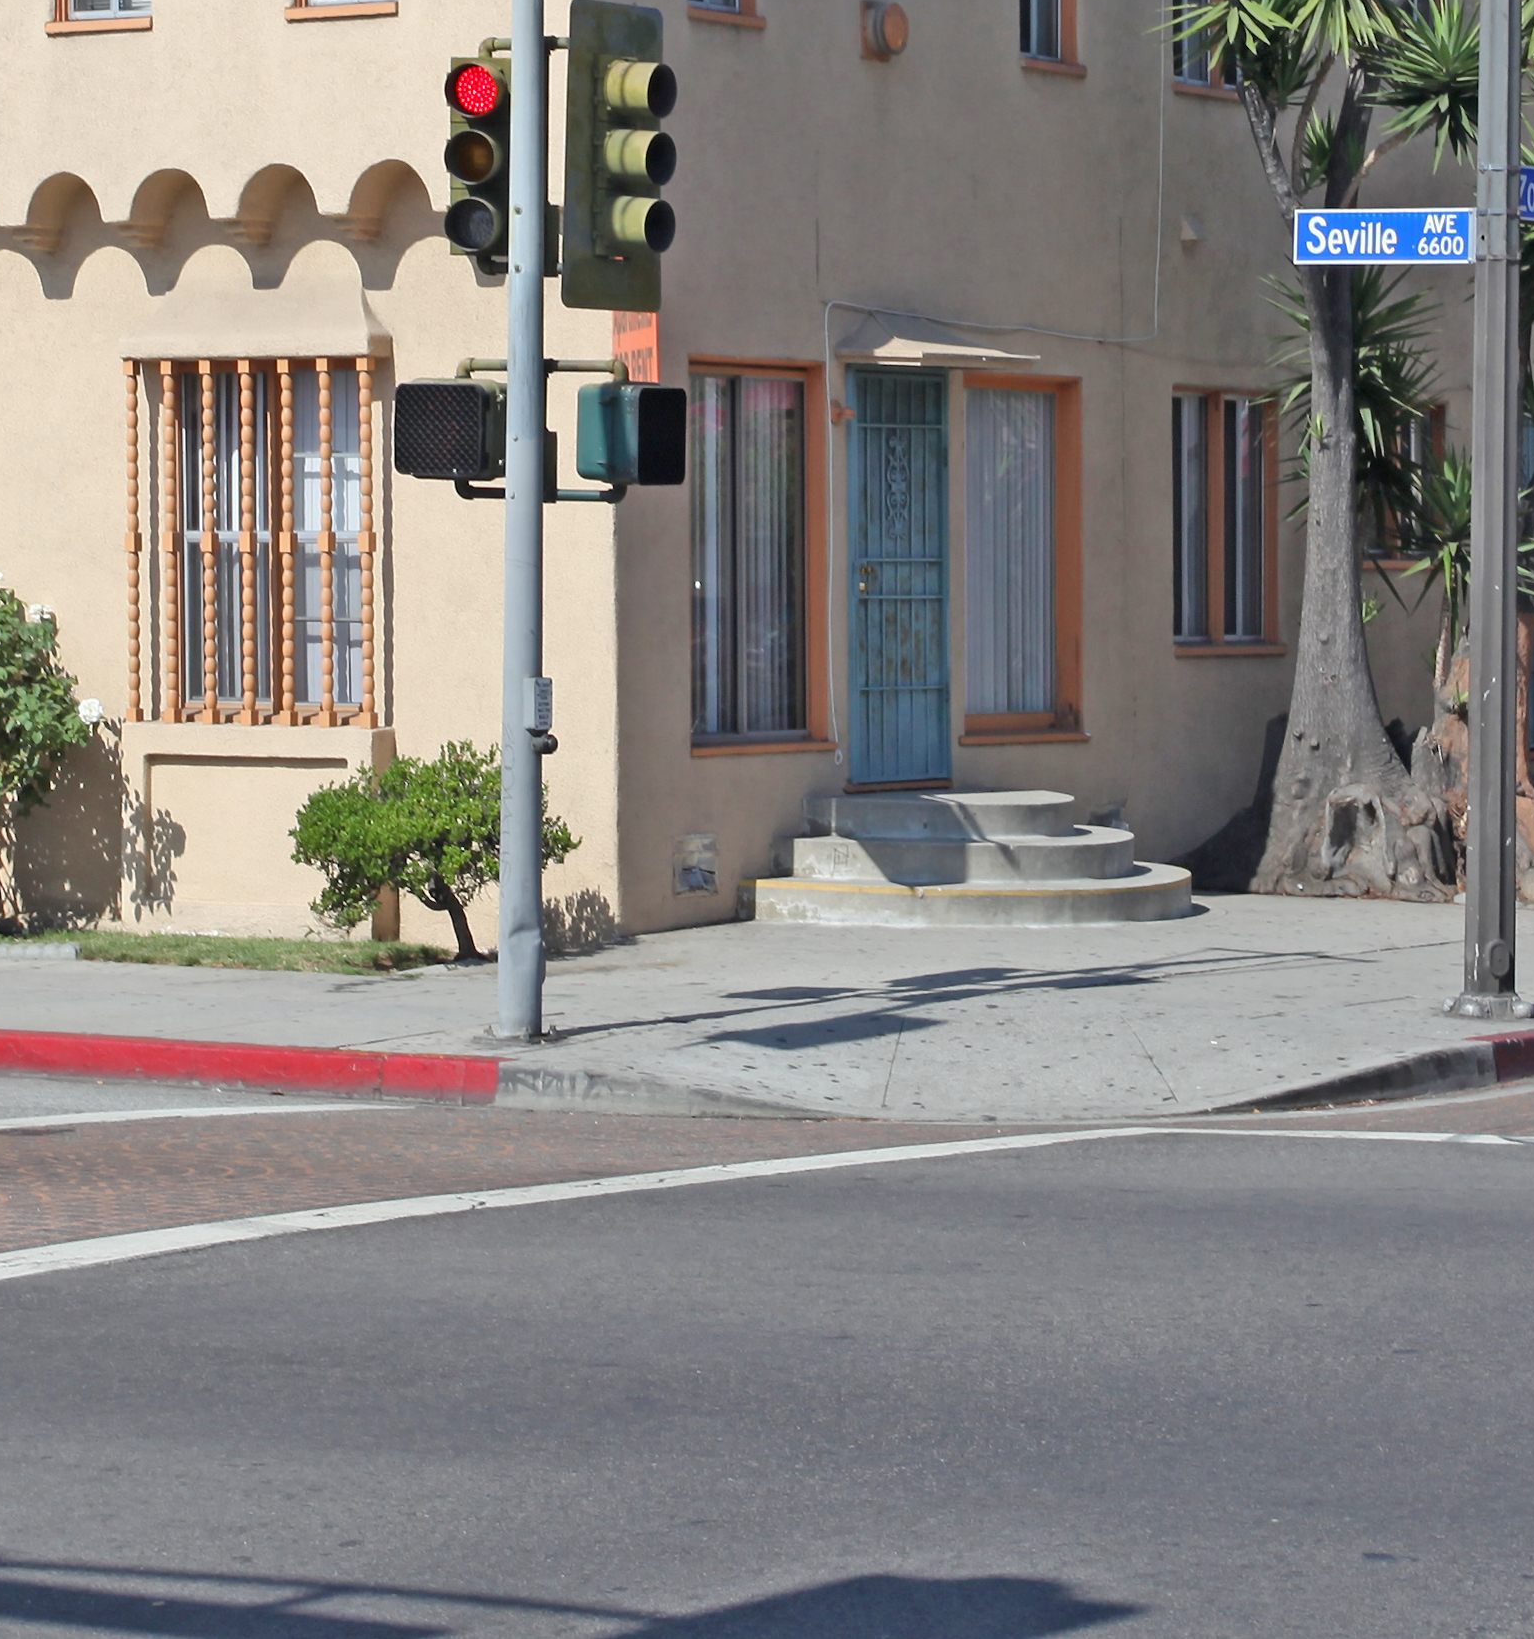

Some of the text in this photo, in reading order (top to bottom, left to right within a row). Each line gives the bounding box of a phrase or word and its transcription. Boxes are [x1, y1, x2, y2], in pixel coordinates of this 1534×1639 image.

[1306, 214, 1457, 255] Seville AVE
[1417, 235, 1464, 255] 6600
